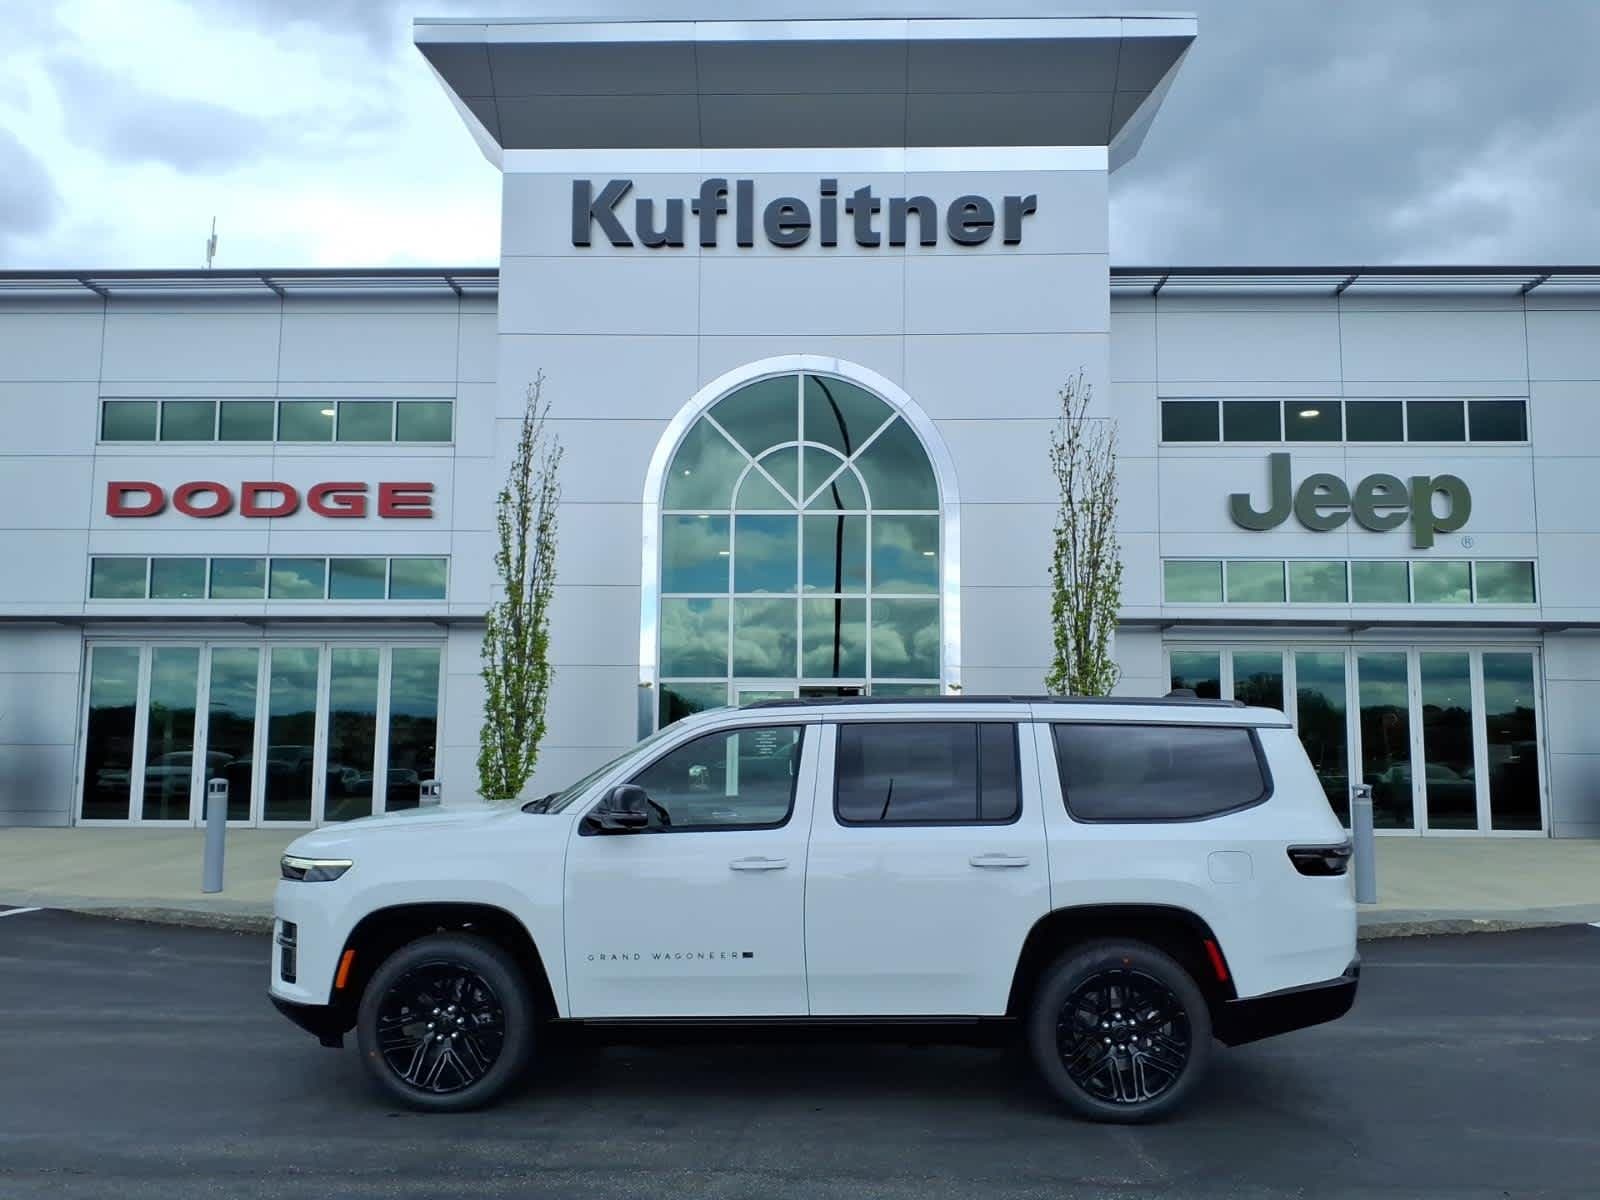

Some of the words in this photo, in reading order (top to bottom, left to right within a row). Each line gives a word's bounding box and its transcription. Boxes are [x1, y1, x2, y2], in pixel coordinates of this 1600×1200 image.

[571, 178, 1038, 248] Kufleitner
[105, 480, 435, 519] DODGE
[1228, 452, 1473, 550] Jeep
[587, 952, 641, 961] GRAND
[652, 952, 739, 960] WAGONEER
